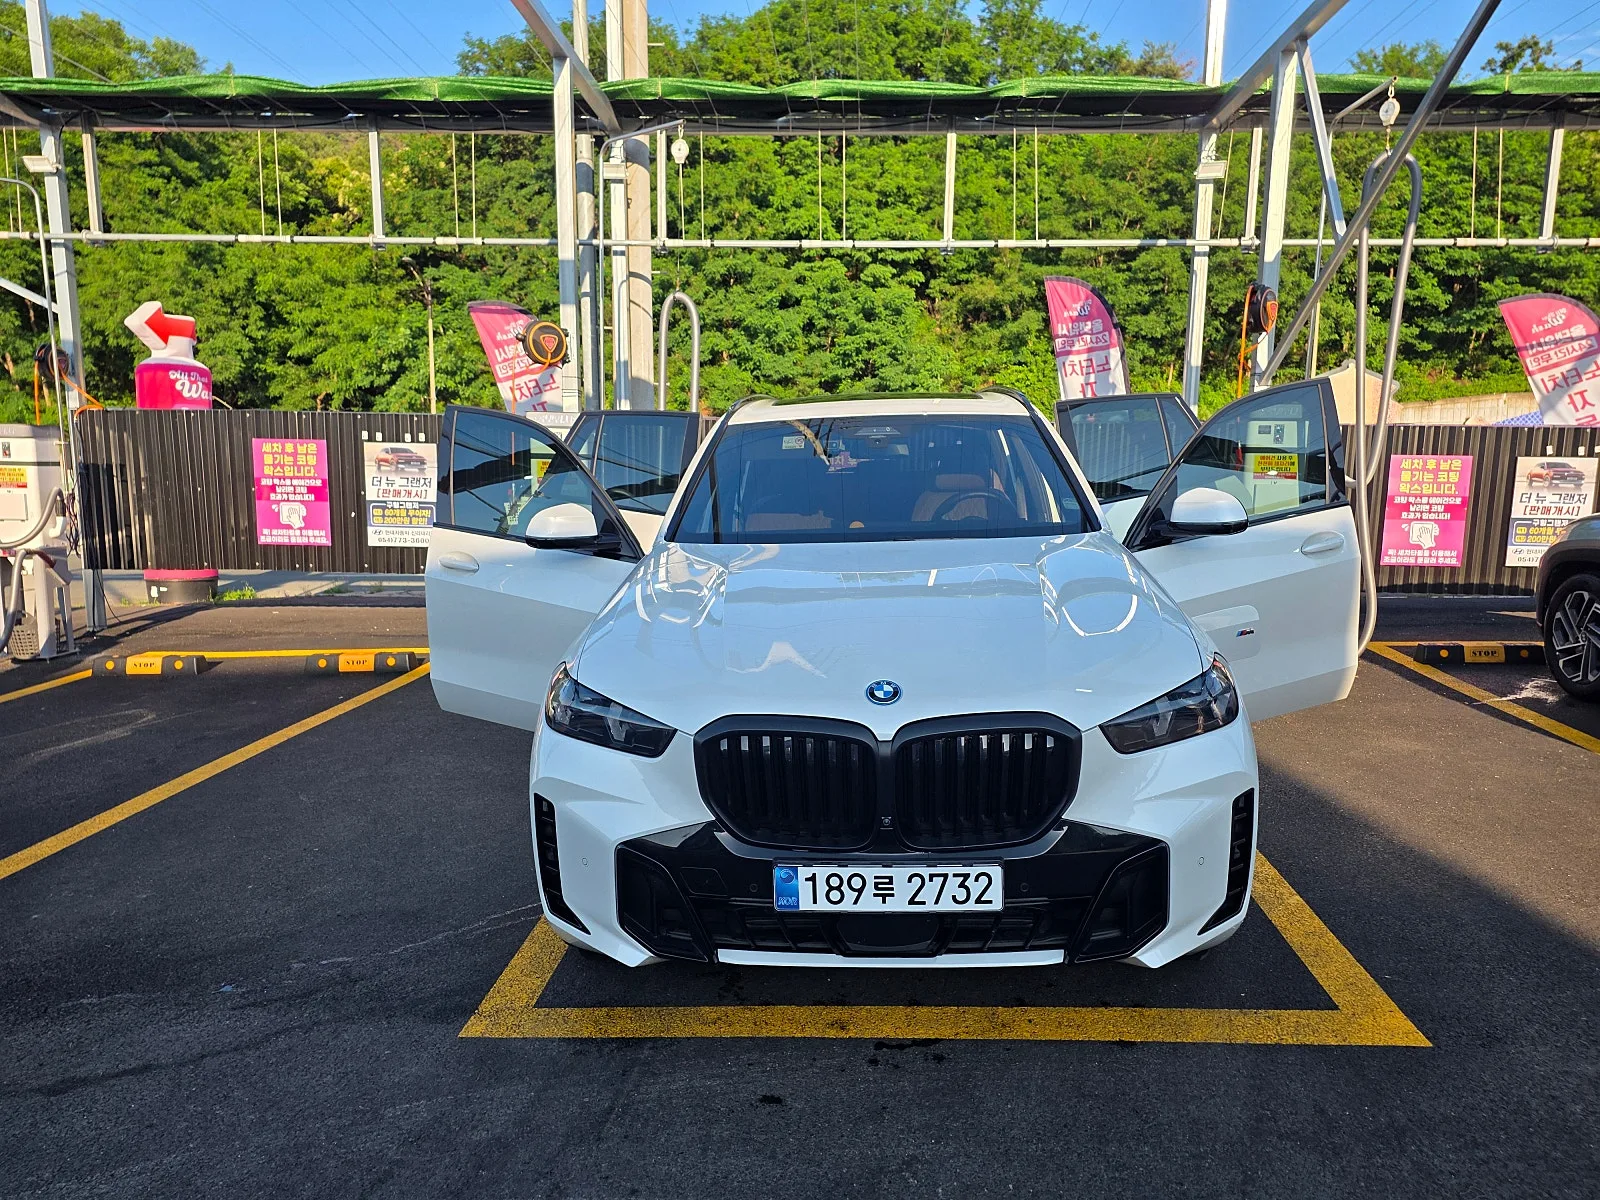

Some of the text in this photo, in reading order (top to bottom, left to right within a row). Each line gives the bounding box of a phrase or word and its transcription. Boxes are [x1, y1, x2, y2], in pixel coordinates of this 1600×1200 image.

[175, 380, 211, 400] Wa
[262, 442, 317, 454] 세차 후 남은
[264, 454, 294, 465] 물기는
[1401, 458, 1462, 471] 세차 후 남은
[263, 466, 318, 477] 왁스입니다.
[1400, 470, 1460, 482] 물기는 코팅
[372, 476, 432, 489] 더 뉴 그랜저
[1399, 482, 1459, 495] 왁스입니다.
[377, 489, 428, 500] [판매개시]
[1520, 492, 1588, 505] 더 뉴 그랜저
[1523, 505, 1581, 517] [판매개시]
[804, 871, 993, 907] 189루 2732
